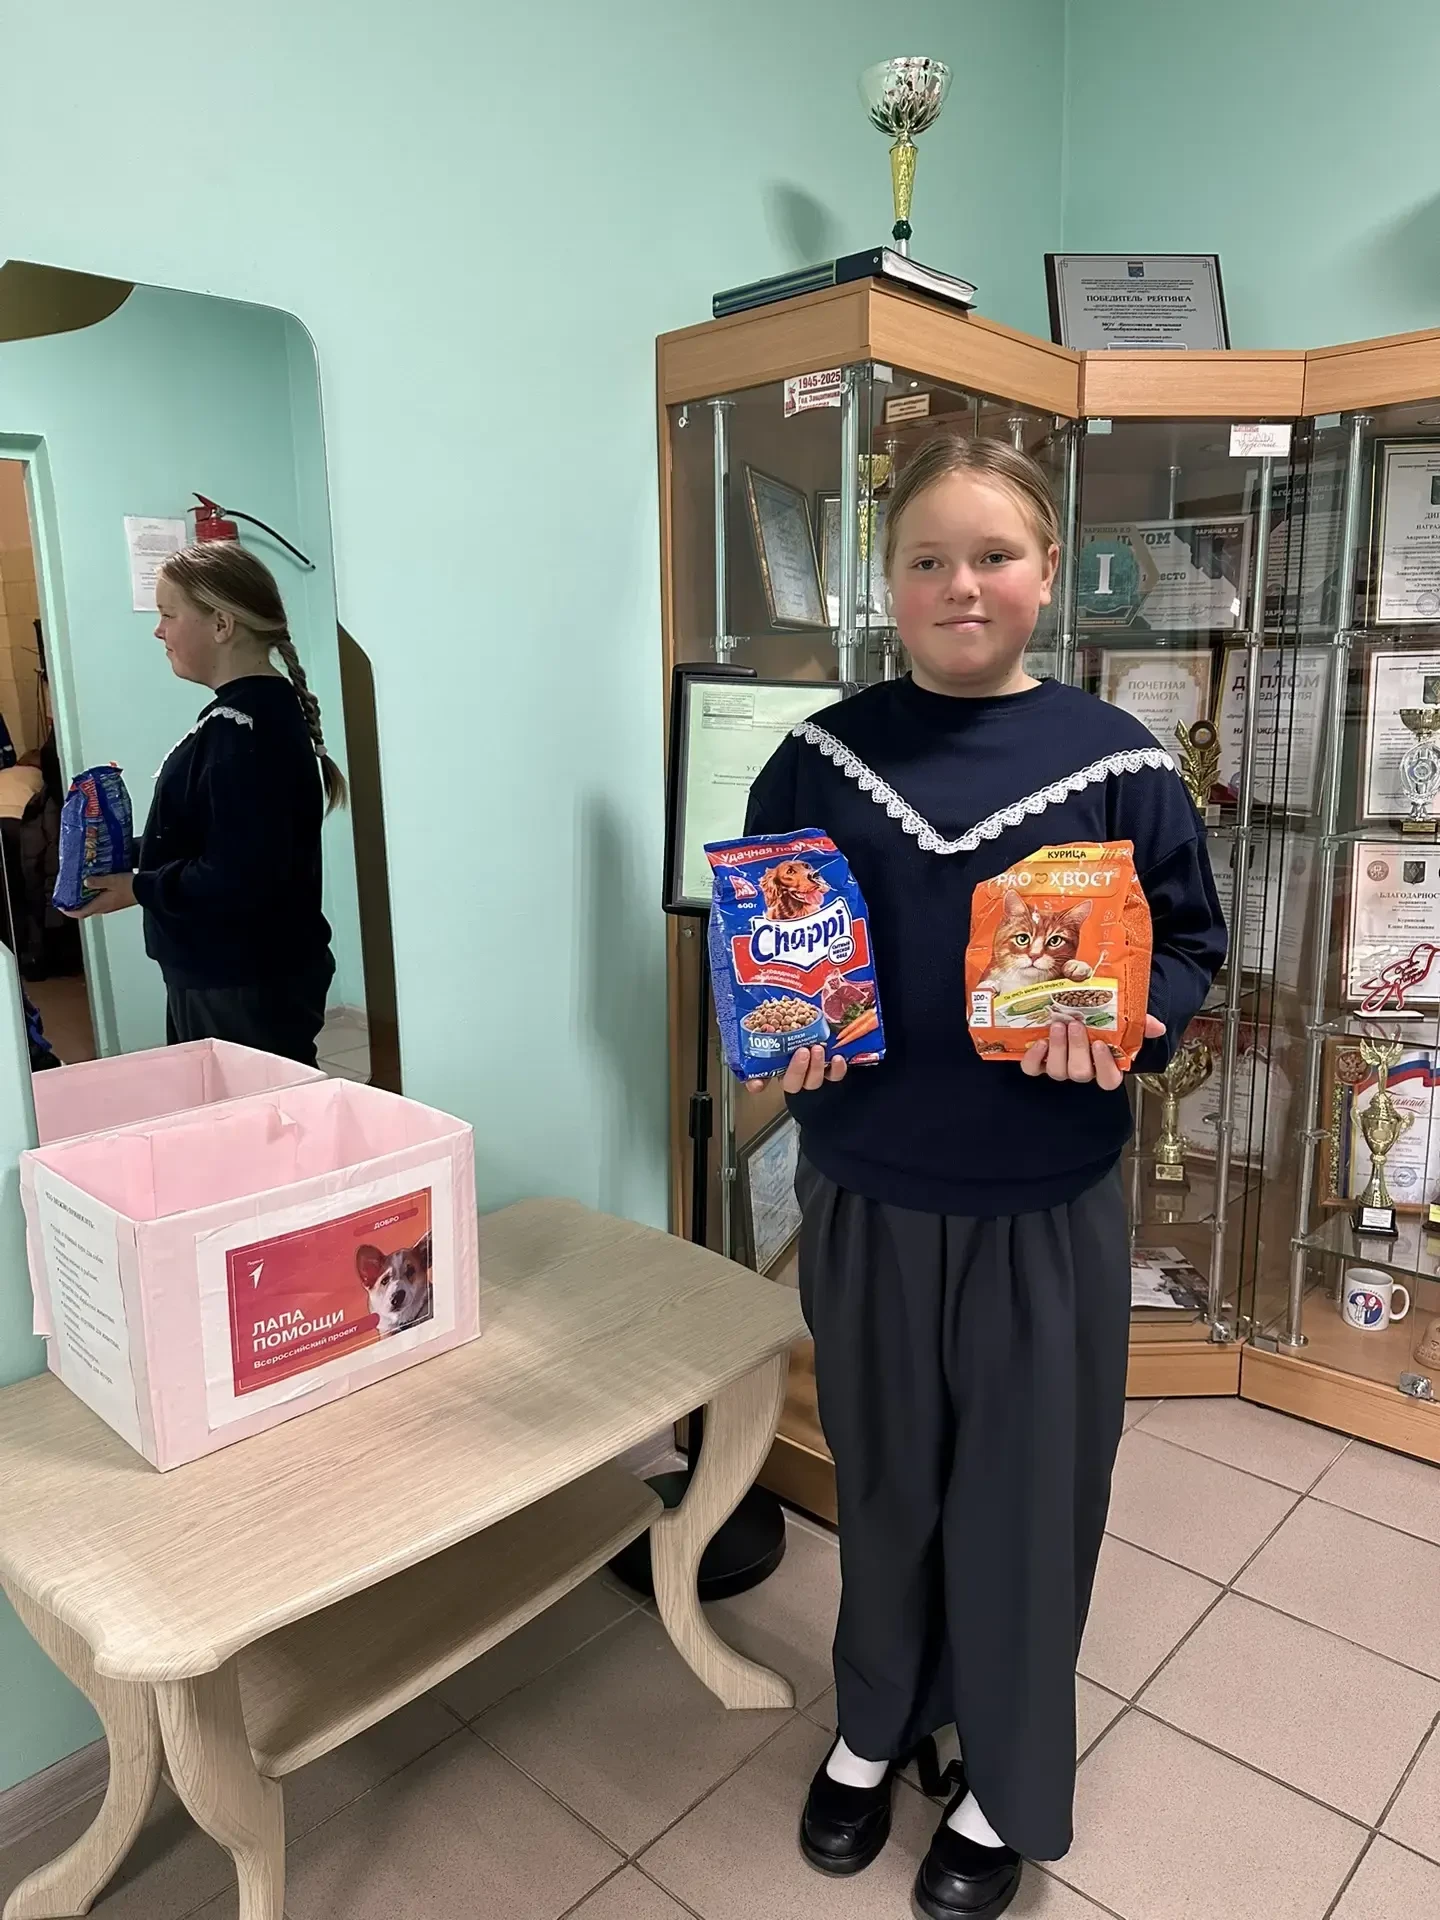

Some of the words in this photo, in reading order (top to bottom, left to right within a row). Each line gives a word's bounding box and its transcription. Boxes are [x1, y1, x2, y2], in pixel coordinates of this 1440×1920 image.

[1147, 294, 1192, 302] РЕЙТИНГА
[798, 370, 841, 389] 1945-2025
[1128, 680, 1186, 690] ПОЧЕТНАЯ
[1232, 674, 1320, 691] ДПЛОМ
[1132, 691, 1180, 701] ГРАМОТА
[720, 847, 773, 863] Удачная
[1047, 850, 1087, 859] КУРИЦА
[996, 871, 1032, 887] PRO
[1049, 870, 1115, 888] ХВОСТ
[751, 908, 845, 963] Chappi
[748, 1036, 781, 1049] 100%
[373, 1215, 400, 1230] ДОБРО
[252, 1308, 305, 1337] ЛАПА
[253, 1309, 345, 1353] ПОМОЩИ
[253, 1337, 327, 1369] Всероссийский
[327, 1325, 358, 1343] проект
